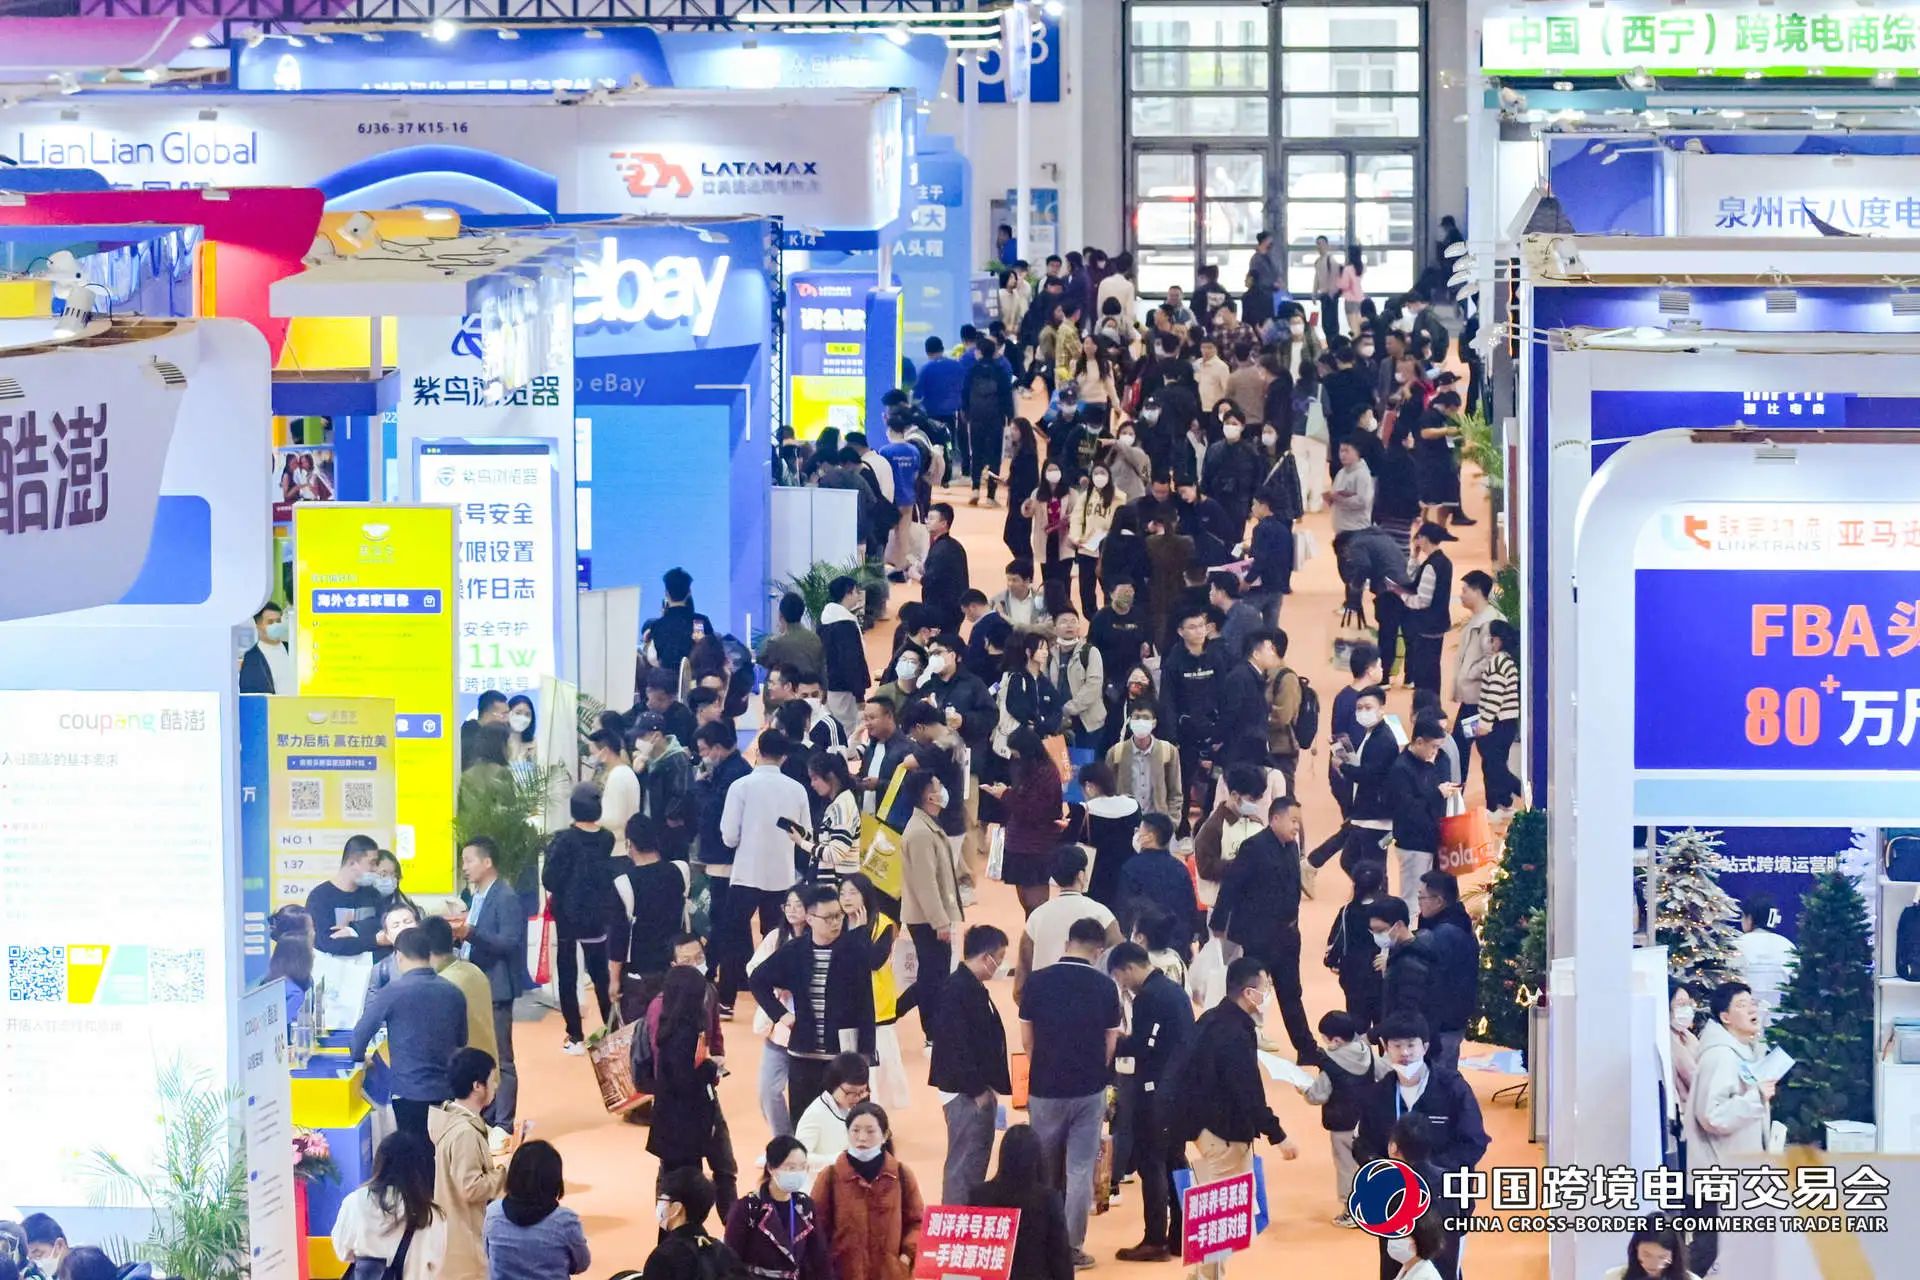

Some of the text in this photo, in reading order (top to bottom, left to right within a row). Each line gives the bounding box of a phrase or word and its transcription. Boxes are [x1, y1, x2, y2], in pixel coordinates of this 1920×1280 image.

[418, 121, 468, 134] K15-16
[18, 131, 257, 165] LianLian Global
[701, 161, 817, 175] LATAMAX
[574, 236, 730, 336] ebay
[590, 373, 646, 394] eBay
[459, 502, 534, 525] 号安全
[459, 540, 534, 563] 限设置
[459, 577, 536, 600] 作日志
[59, 708, 206, 736] coupang 酷澎
[1188, 1180, 1249, 1220] 测评养号系统
[926, 1212, 1012, 1240] 测评养号系统
[922, 1242, 1007, 1271] 一手资源对接
